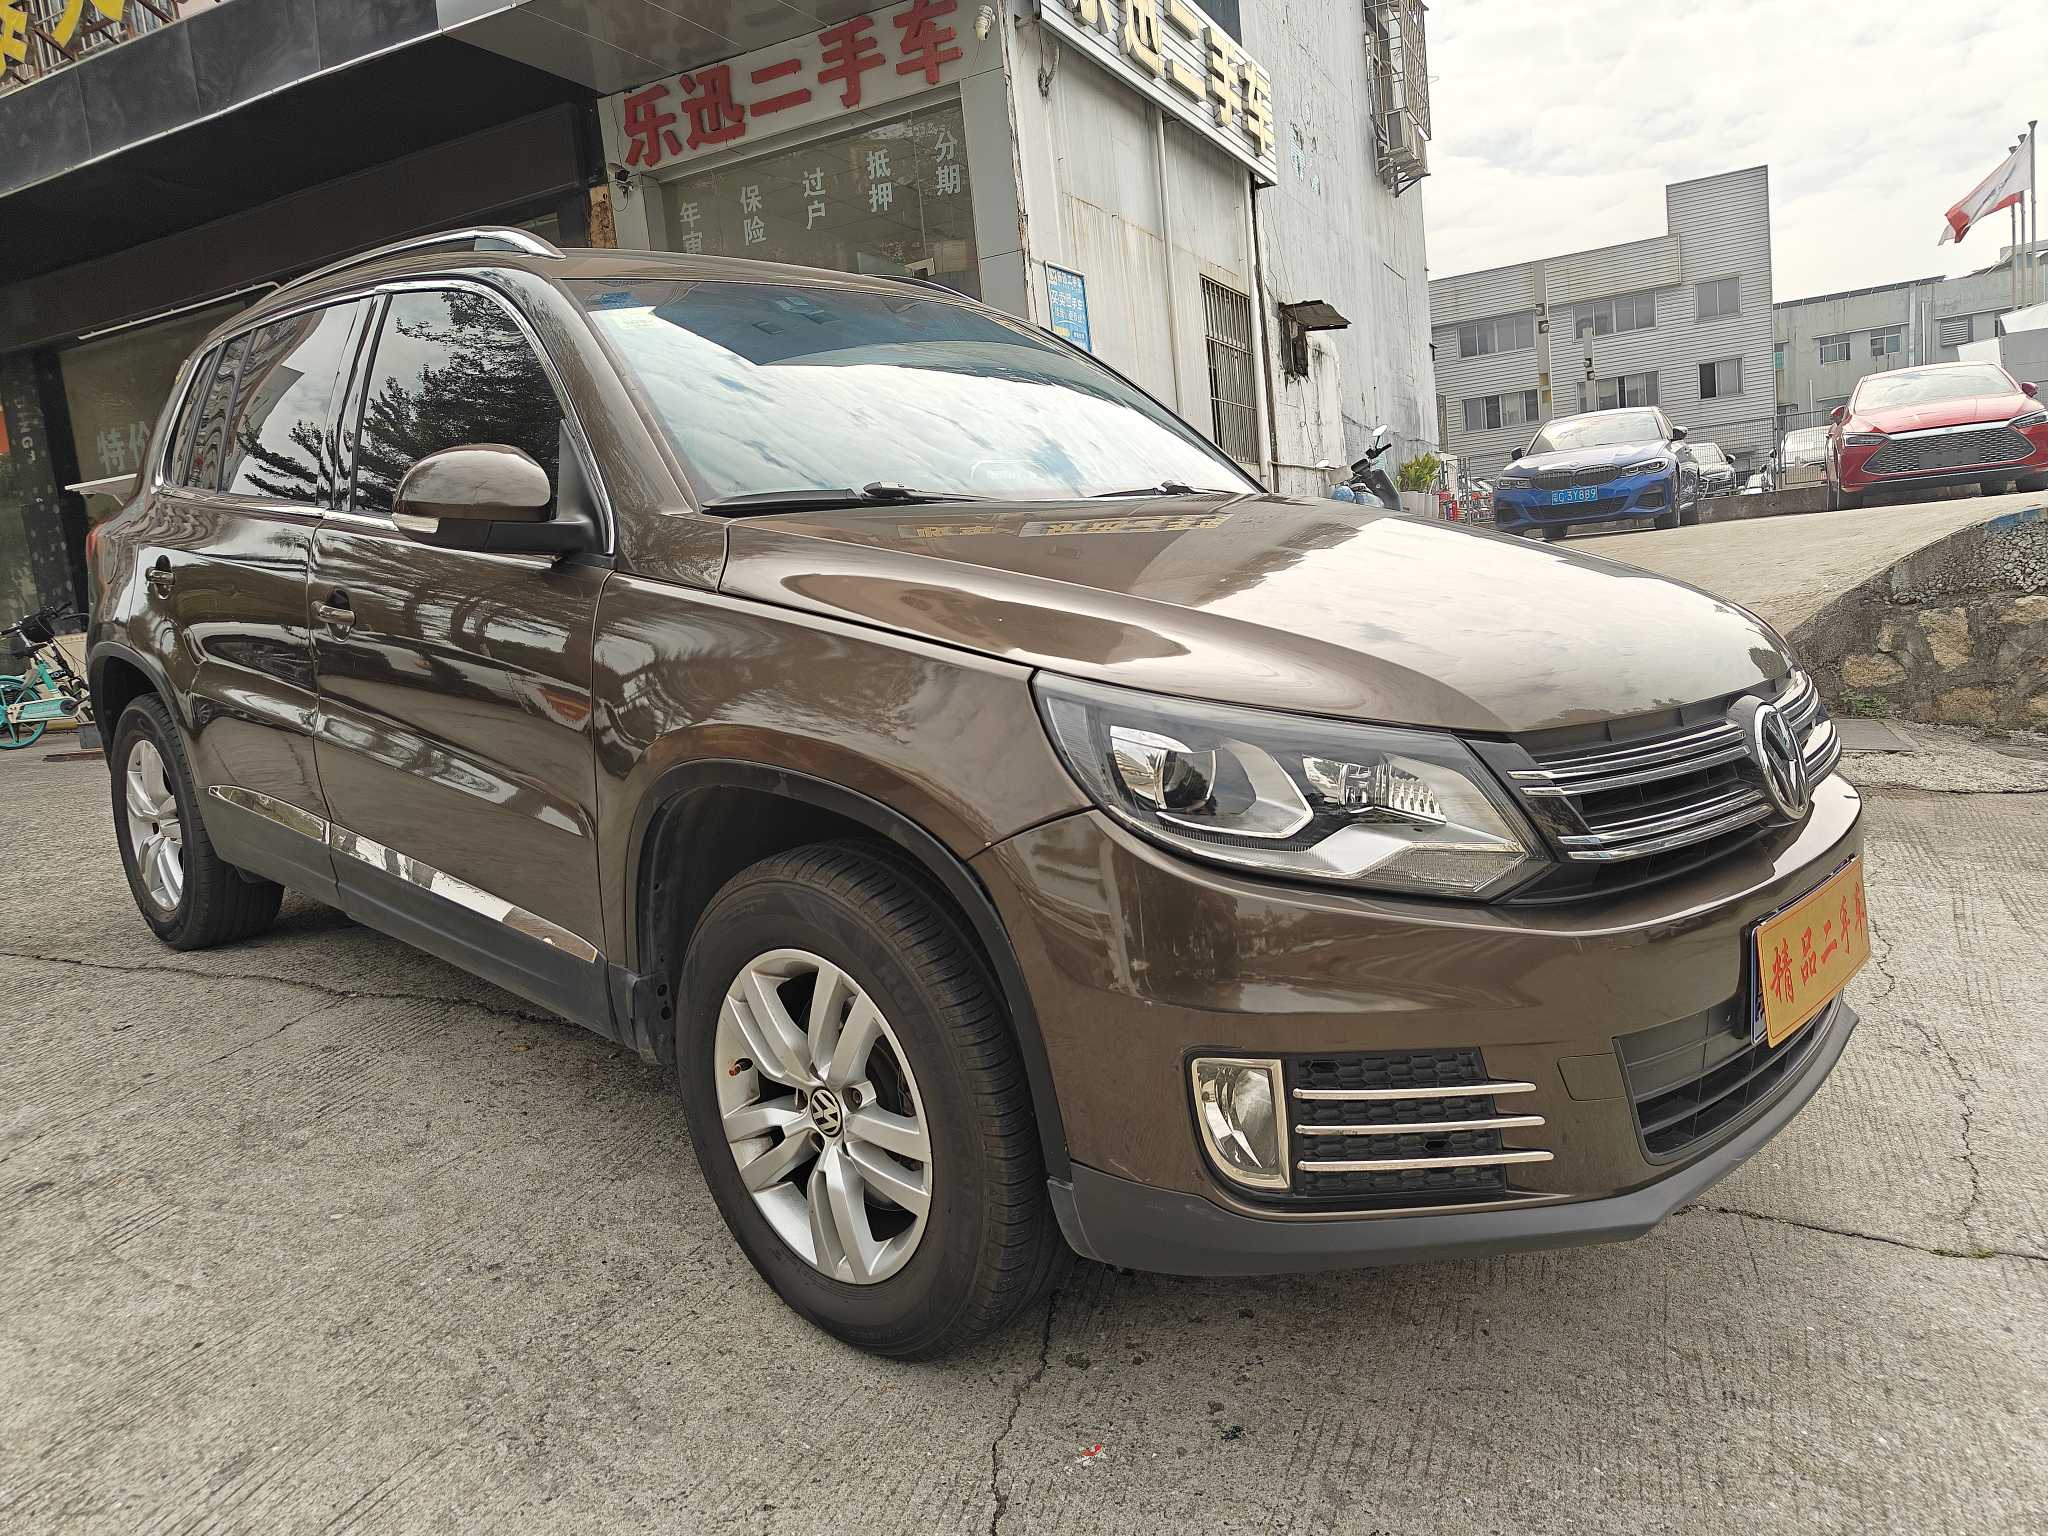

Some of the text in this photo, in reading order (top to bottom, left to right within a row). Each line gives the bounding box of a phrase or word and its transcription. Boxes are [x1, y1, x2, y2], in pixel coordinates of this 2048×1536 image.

[624, 0, 962, 167] 乐迅二手车
[866, 149, 893, 213] 抵押
[935, 133, 961, 196] 分期
[740, 184, 767, 246] 保险
[802, 167, 826, 231] 过户
[1771, 881, 1865, 1003] 精品二手车
